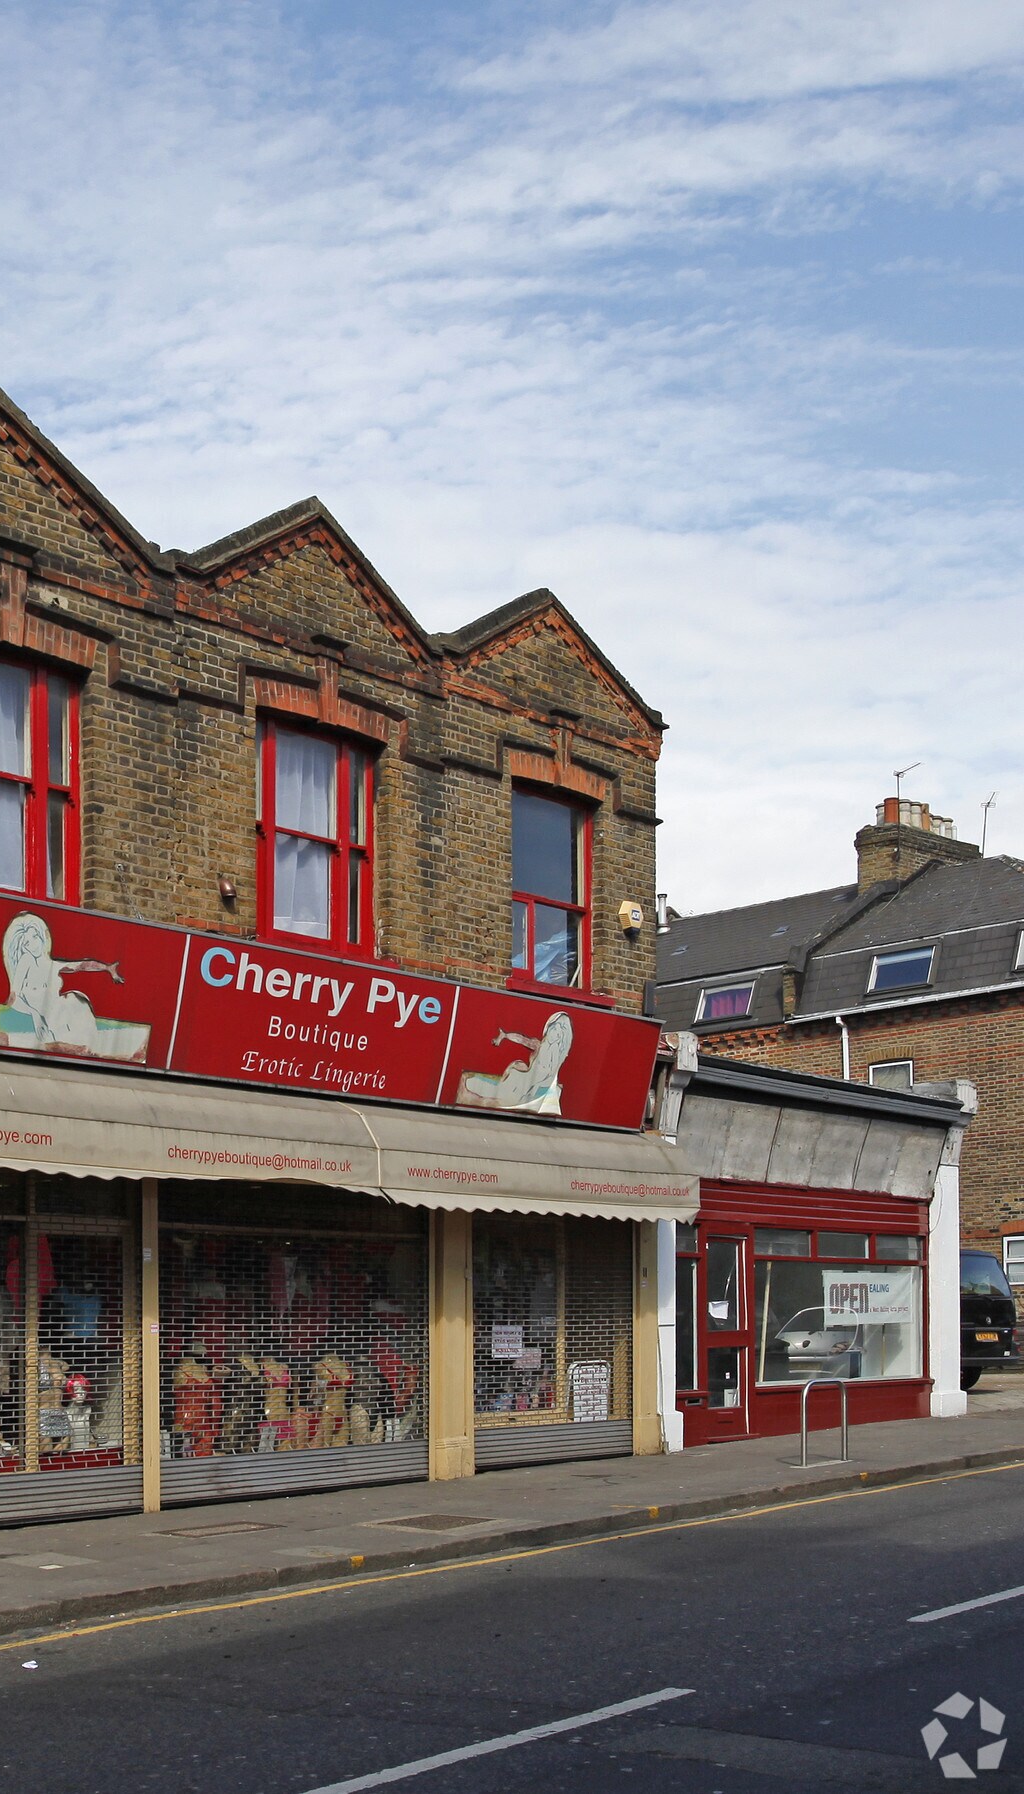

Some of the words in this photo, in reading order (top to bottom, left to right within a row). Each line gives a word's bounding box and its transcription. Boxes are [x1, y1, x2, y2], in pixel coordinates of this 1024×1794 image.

[200, 946, 354, 1017] Cherry
[366, 977, 441, 1028] Pye
[267, 1015, 368, 1052] Boutique
[240, 1050, 303, 1078] Erotic
[309, 1060, 386, 1093] Lingerie
[168, 1145, 351, 1172] cherrypyeboutique@hotmail.co.uk
[407, 1166, 498, 1184] www.cherrypye.com
[570, 1179, 690, 1198] cherrypyeboutique@hotmail.co.uk
[829, 1283, 869, 1314] OPEN
[869, 1283, 890, 1293] EALING
